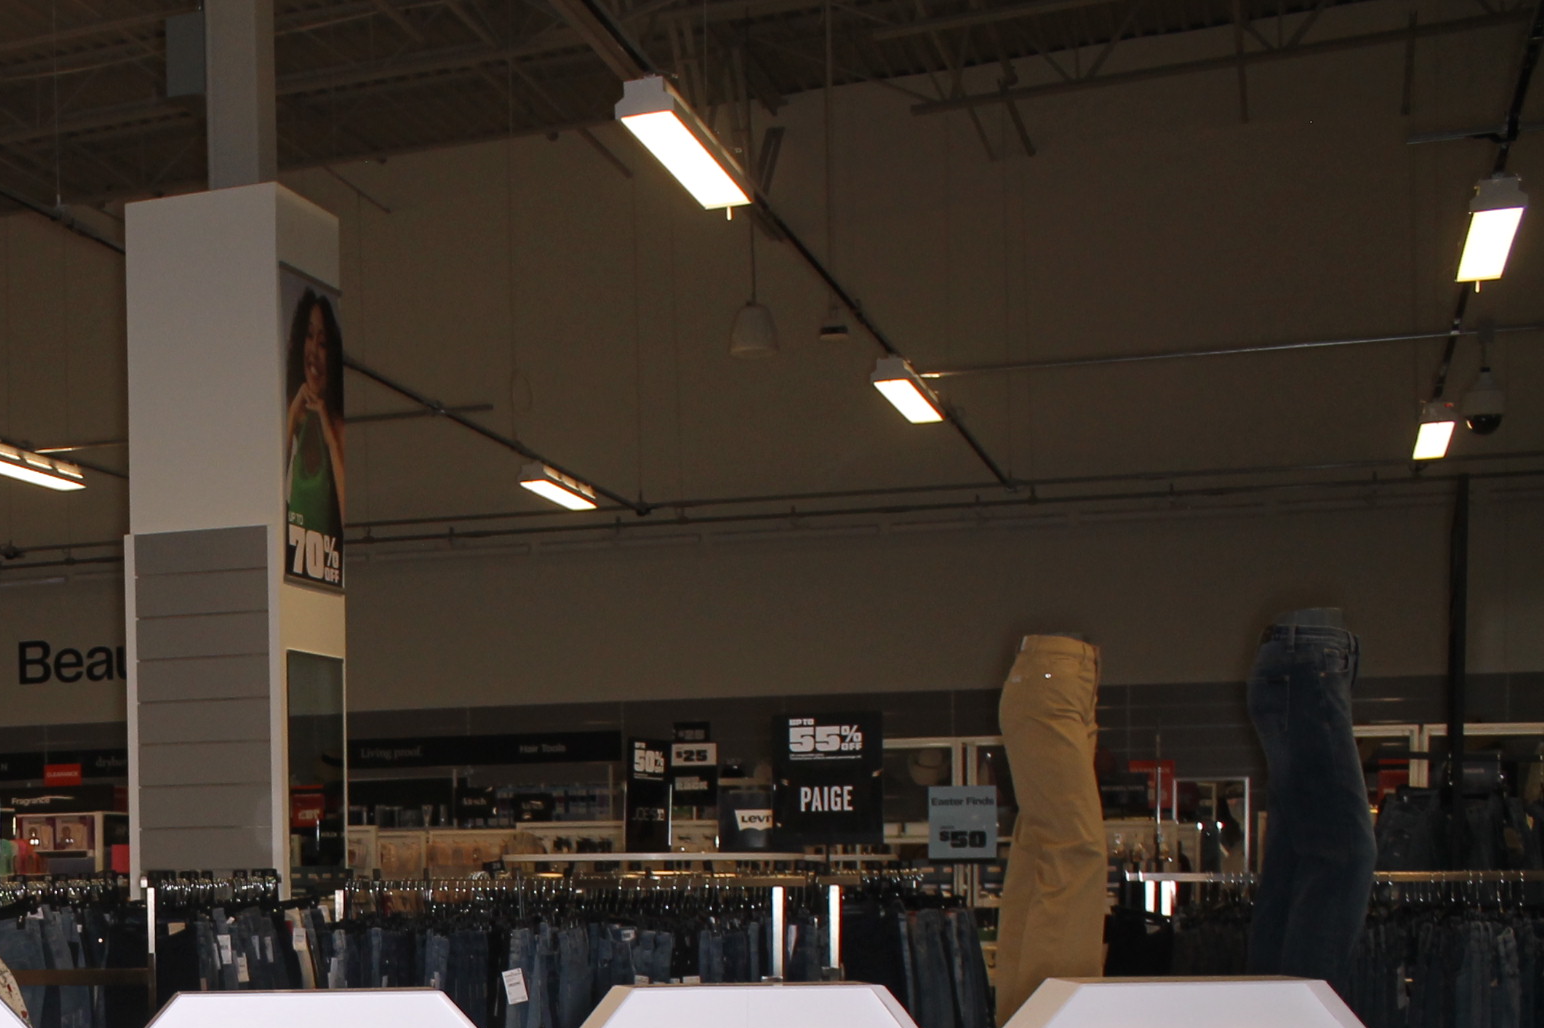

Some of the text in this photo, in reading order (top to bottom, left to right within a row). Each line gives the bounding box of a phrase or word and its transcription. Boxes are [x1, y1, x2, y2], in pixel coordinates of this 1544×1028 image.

[288, 522, 340, 580] 70%
[324, 566, 341, 584] OFF
[789, 725, 863, 753] 55%
[840, 743, 863, 751] OFF
[799, 785, 855, 813] PAIGE
[939, 830, 987, 849] $50
